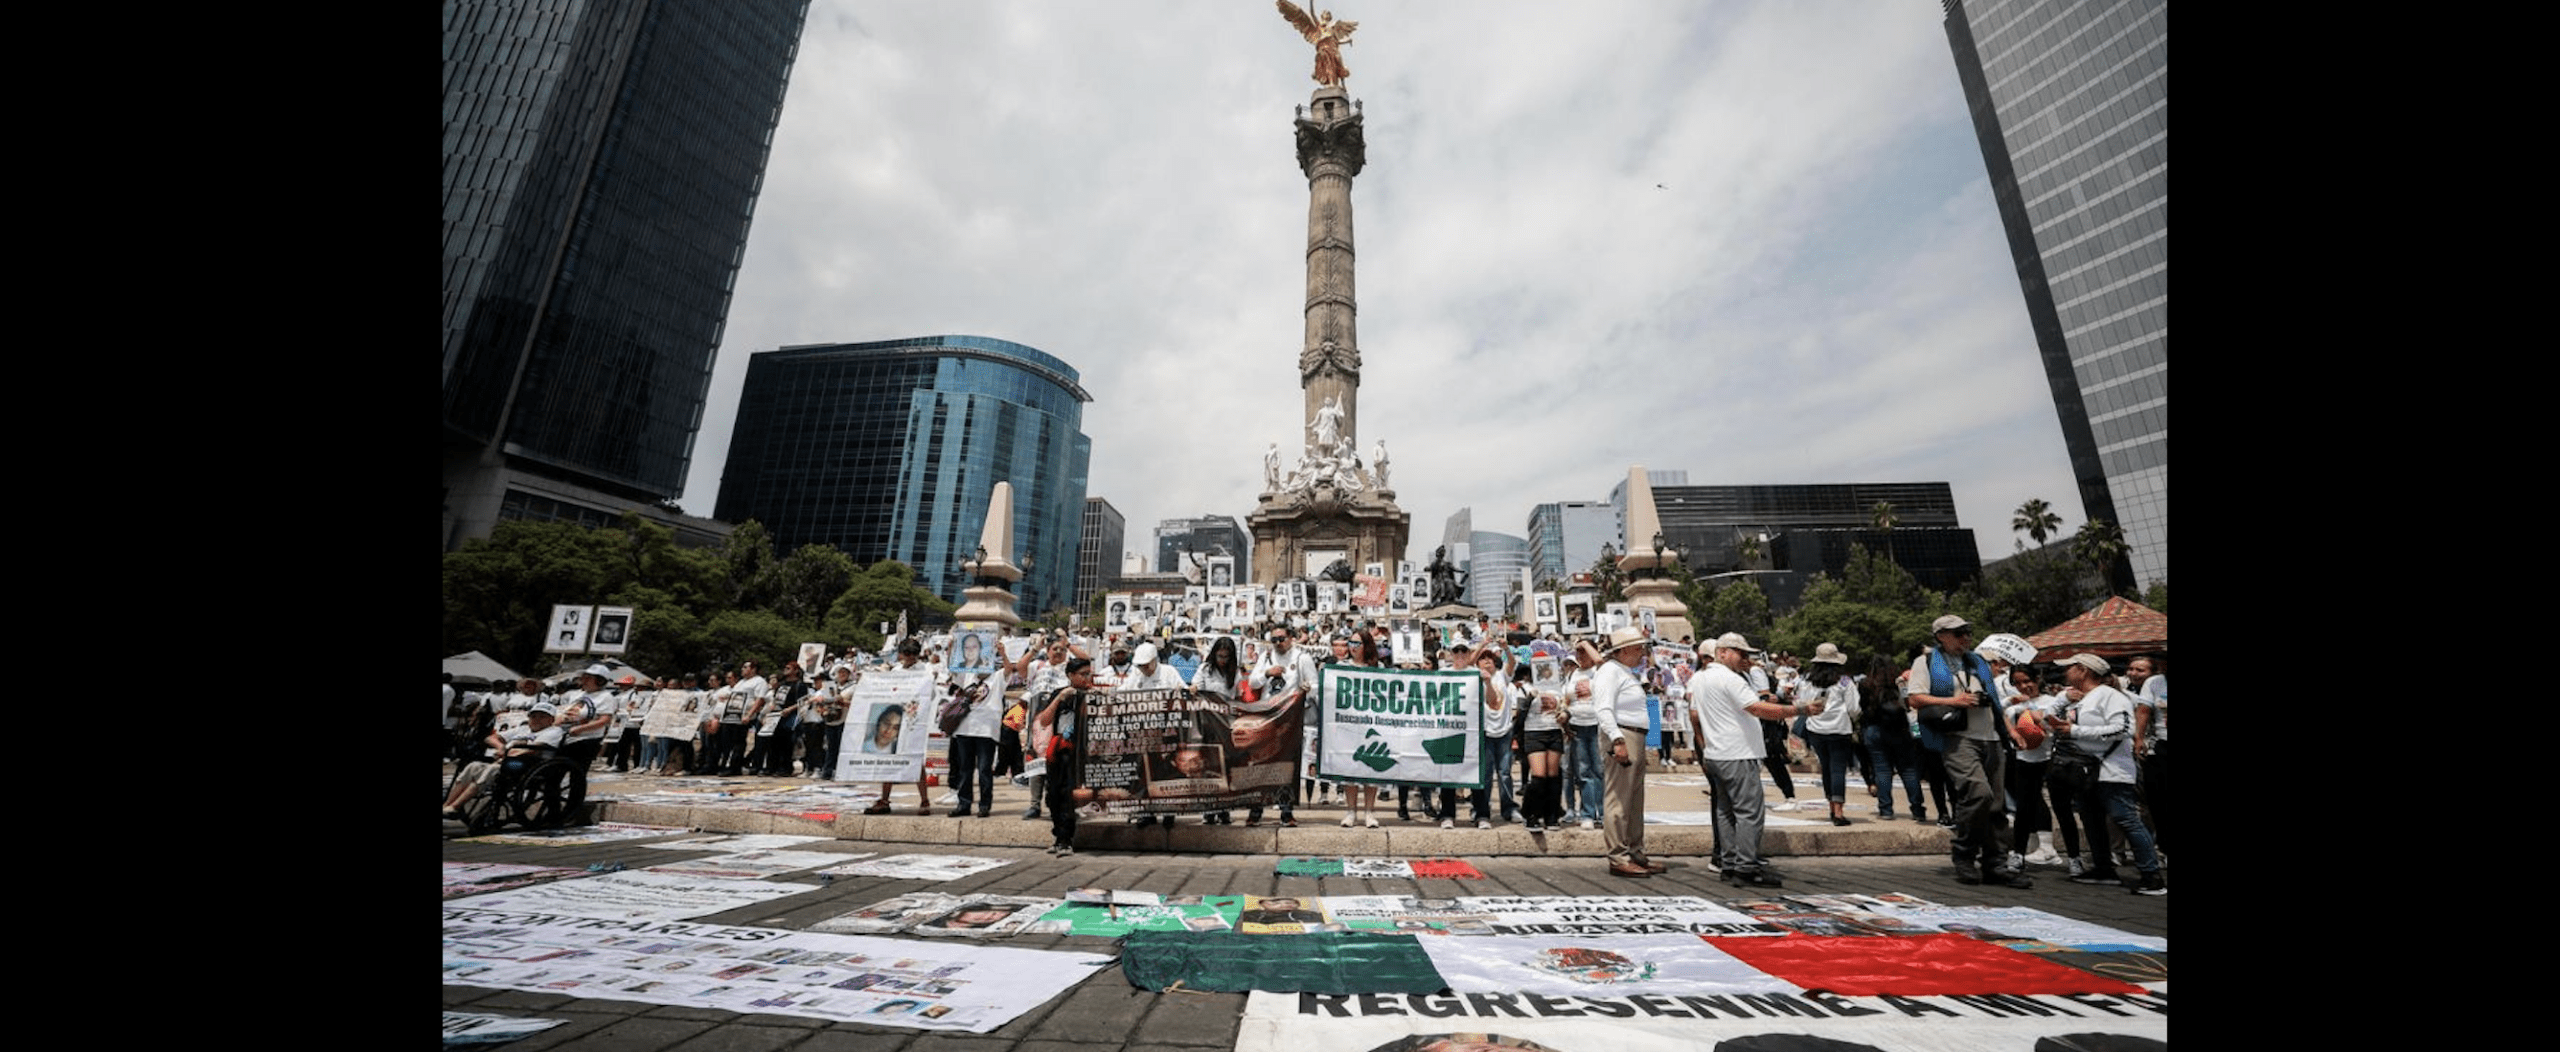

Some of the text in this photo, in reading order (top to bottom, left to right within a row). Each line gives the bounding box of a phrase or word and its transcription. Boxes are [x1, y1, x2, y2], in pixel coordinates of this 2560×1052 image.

[1085, 690, 1187, 705] PRESIDENTA:
[1335, 676, 1467, 716] BUSCAME
[1087, 705, 1107, 716] DE
[1112, 701, 1168, 716] MADRE
[1172, 700, 1182, 711] A
[1168, 712, 1182, 721] EN
[1088, 723, 1140, 733] NUESTRO
[1144, 720, 1179, 730] LUGAR
[1088, 732, 1127, 741] FUERA
[1878, 994, 1962, 1018] A
